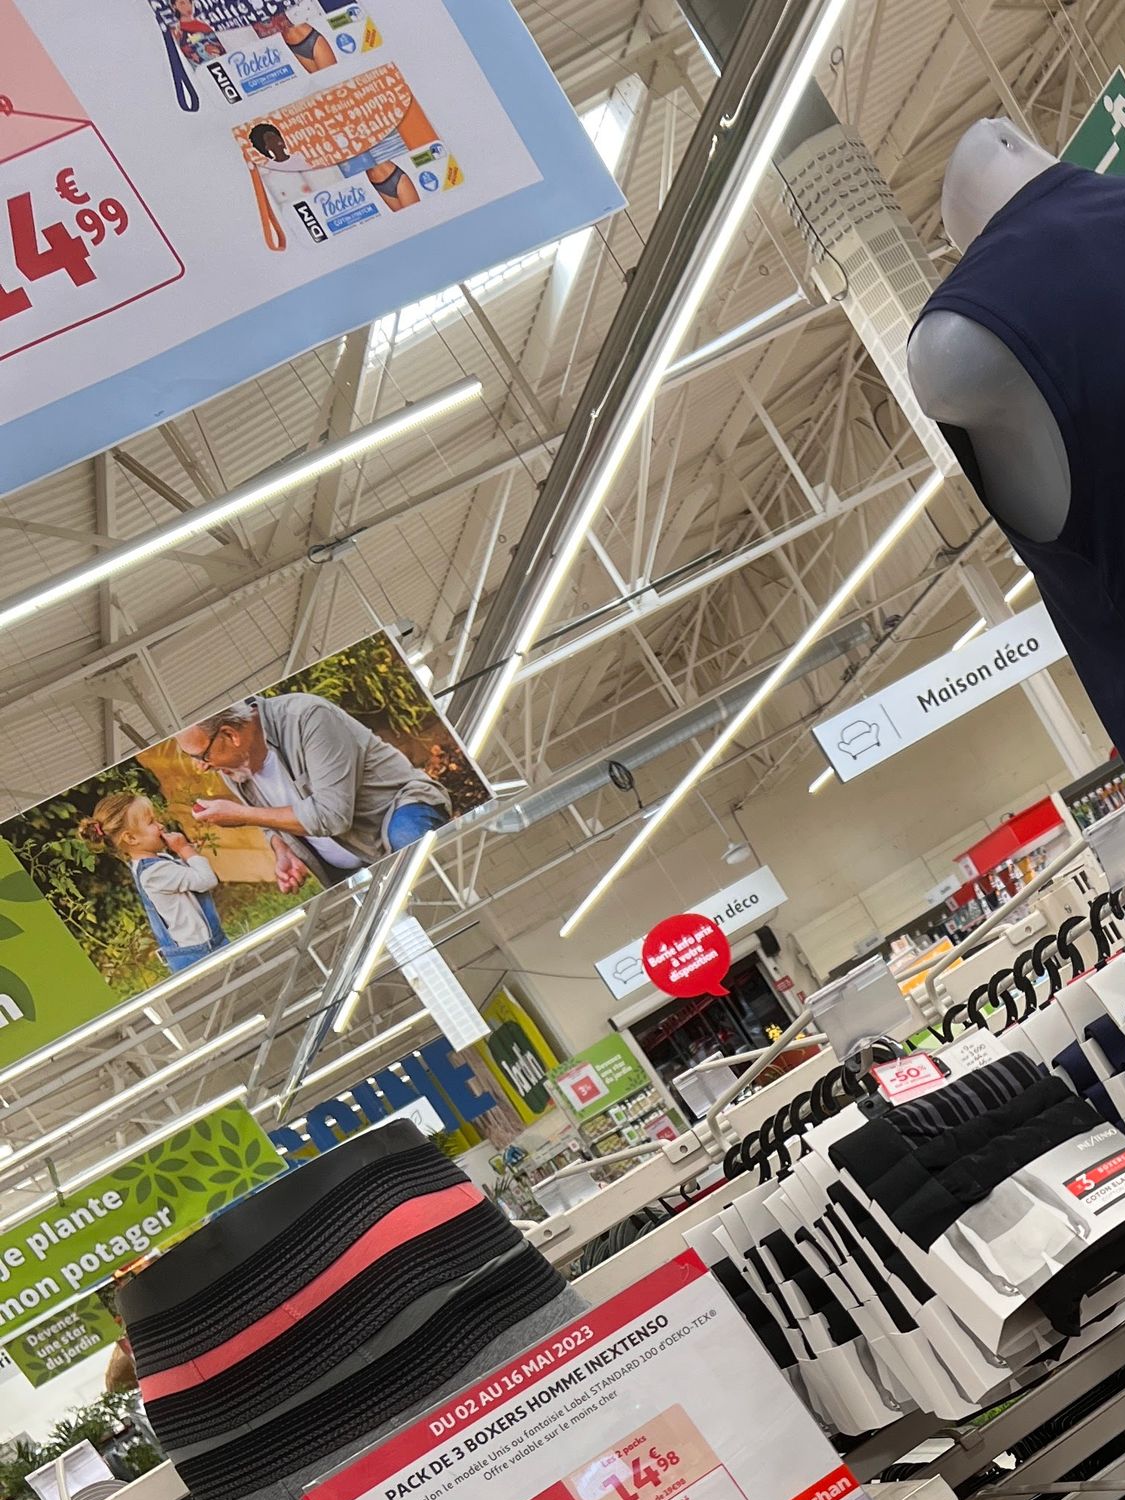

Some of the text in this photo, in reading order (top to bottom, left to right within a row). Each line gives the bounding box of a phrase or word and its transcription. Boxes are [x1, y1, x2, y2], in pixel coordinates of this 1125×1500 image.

[228, 47, 281, 78] Pockets
[212, 66, 238, 102] DIM
[314, 186, 366, 217] Pockets
[299, 205, 325, 242] DIM
[915, 630, 1041, 713] Maison déco
[722, 889, 760, 918] déco
[691, 923, 714, 943] prix
[667, 946, 720, 985] disposition
[677, 943, 704, 963] votre
[22, 1180, 127, 1262] plante
[0, 1202, 180, 1327] mon potager
[25, 1309, 80, 1347] Devenez
[35, 1322, 87, 1359] une star
[43, 1329, 103, 1371] du jardin
[428, 1323, 595, 1437] DU 02 AU 16 MAI 2023
[428, 1451, 454, 1476] DE
[450, 1444, 466, 1461] 3
[463, 1403, 529, 1453] BOXERS
[525, 1366, 586, 1412] HOMME
[584, 1312, 670, 1375] INEXTENSO
[441, 1479, 454, 1492] le
[452, 1456, 489, 1485] modèle
[487, 1442, 511, 1462] Unis
[522, 1407, 565, 1439] fantaisie
[563, 1390, 590, 1412] Label
[589, 1357, 641, 1396] STANDARD
[639, 1346, 658, 1363] 100
[481, 1388, 619, 1482] Offre valable sur le moins cher
[620, 1433, 648, 1456] packs
[654, 1449, 681, 1473] 98
